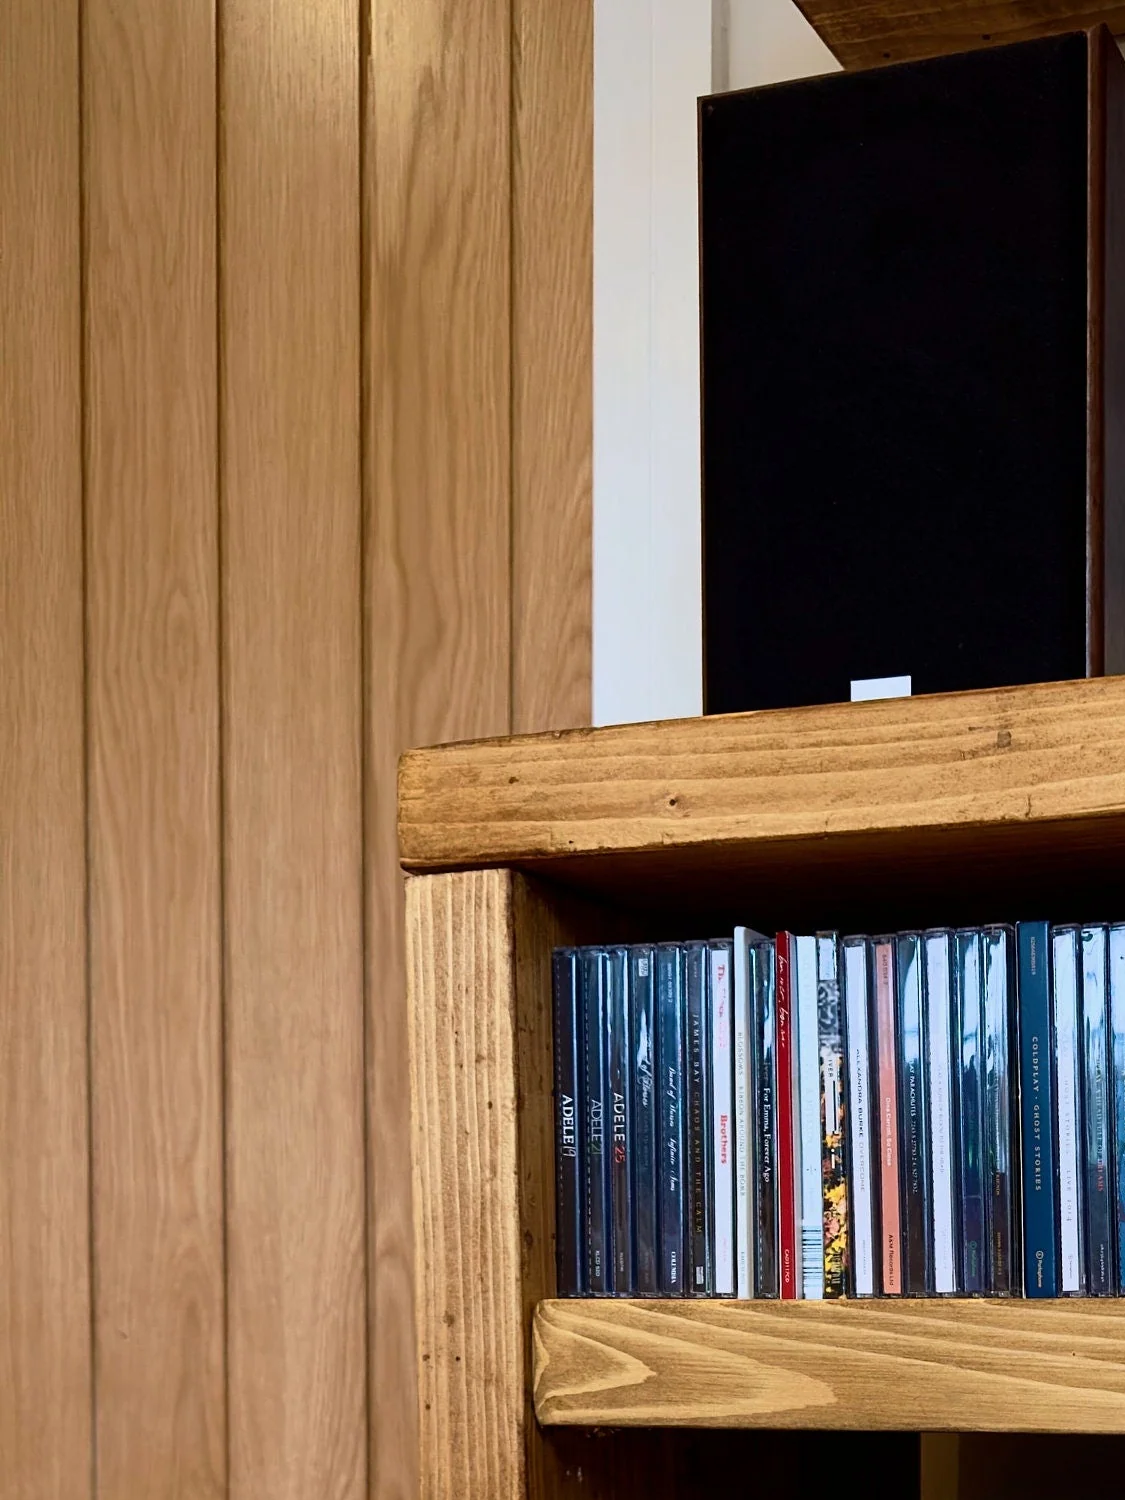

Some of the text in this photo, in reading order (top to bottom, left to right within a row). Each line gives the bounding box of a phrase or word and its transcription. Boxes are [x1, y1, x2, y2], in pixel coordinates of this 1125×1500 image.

[763, 1087, 771, 1102] For
[763, 1104, 771, 1132] Emma,
[562, 1094, 577, 1158] ADELE 19
[591, 1100, 602, 1155] ADELE 21
[614, 1093, 625, 1163] ADELE 25
[720, 1114, 728, 1164] Brothers
[762, 1166, 771, 1183] Ago
[1034, 1146, 1042, 1191] STORIES
